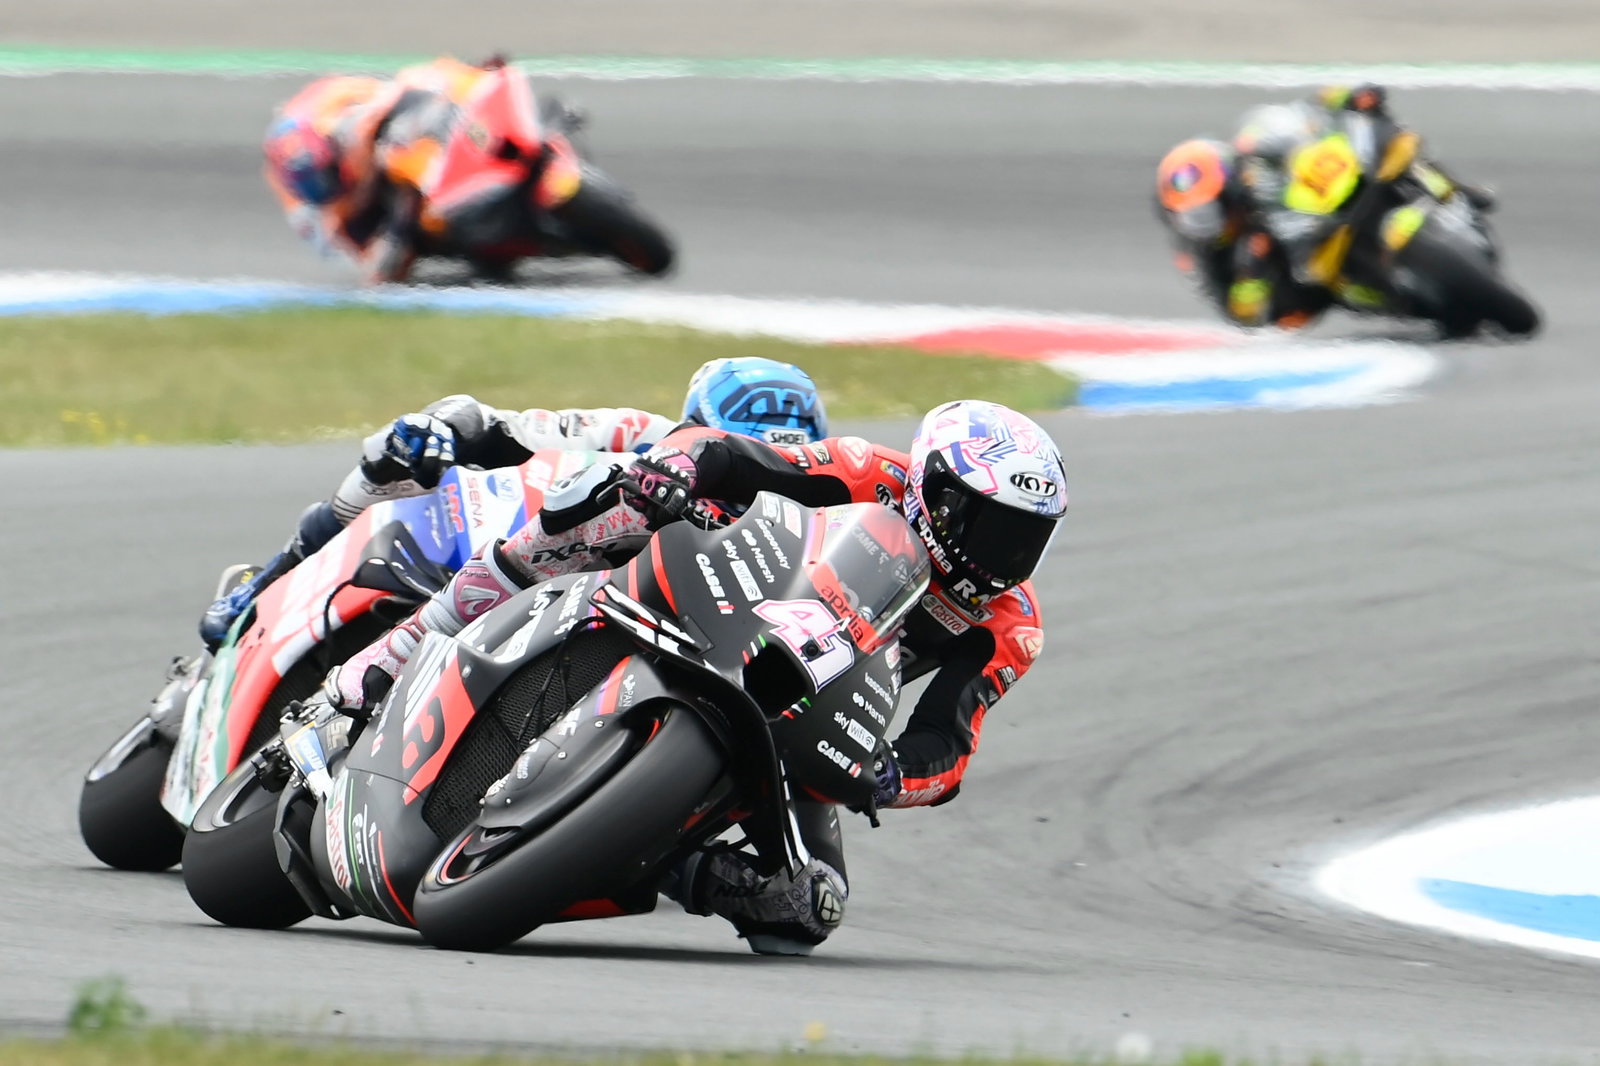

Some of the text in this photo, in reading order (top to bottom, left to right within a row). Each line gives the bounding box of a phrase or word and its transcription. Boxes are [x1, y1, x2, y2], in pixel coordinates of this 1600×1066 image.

[1012, 473, 1057, 495] KYT
[466, 477, 484, 529] SENA
[722, 539, 740, 560] sky
[917, 516, 953, 574] aprilia
[695, 553, 725, 598] CASE
[750, 546, 776, 584] Marsh
[930, 604, 965, 633] Castrol
[751, 599, 855, 694] 41
[833, 711, 850, 731] sky
[864, 700, 887, 728] Marsh
[816, 740, 852, 770] CASE
